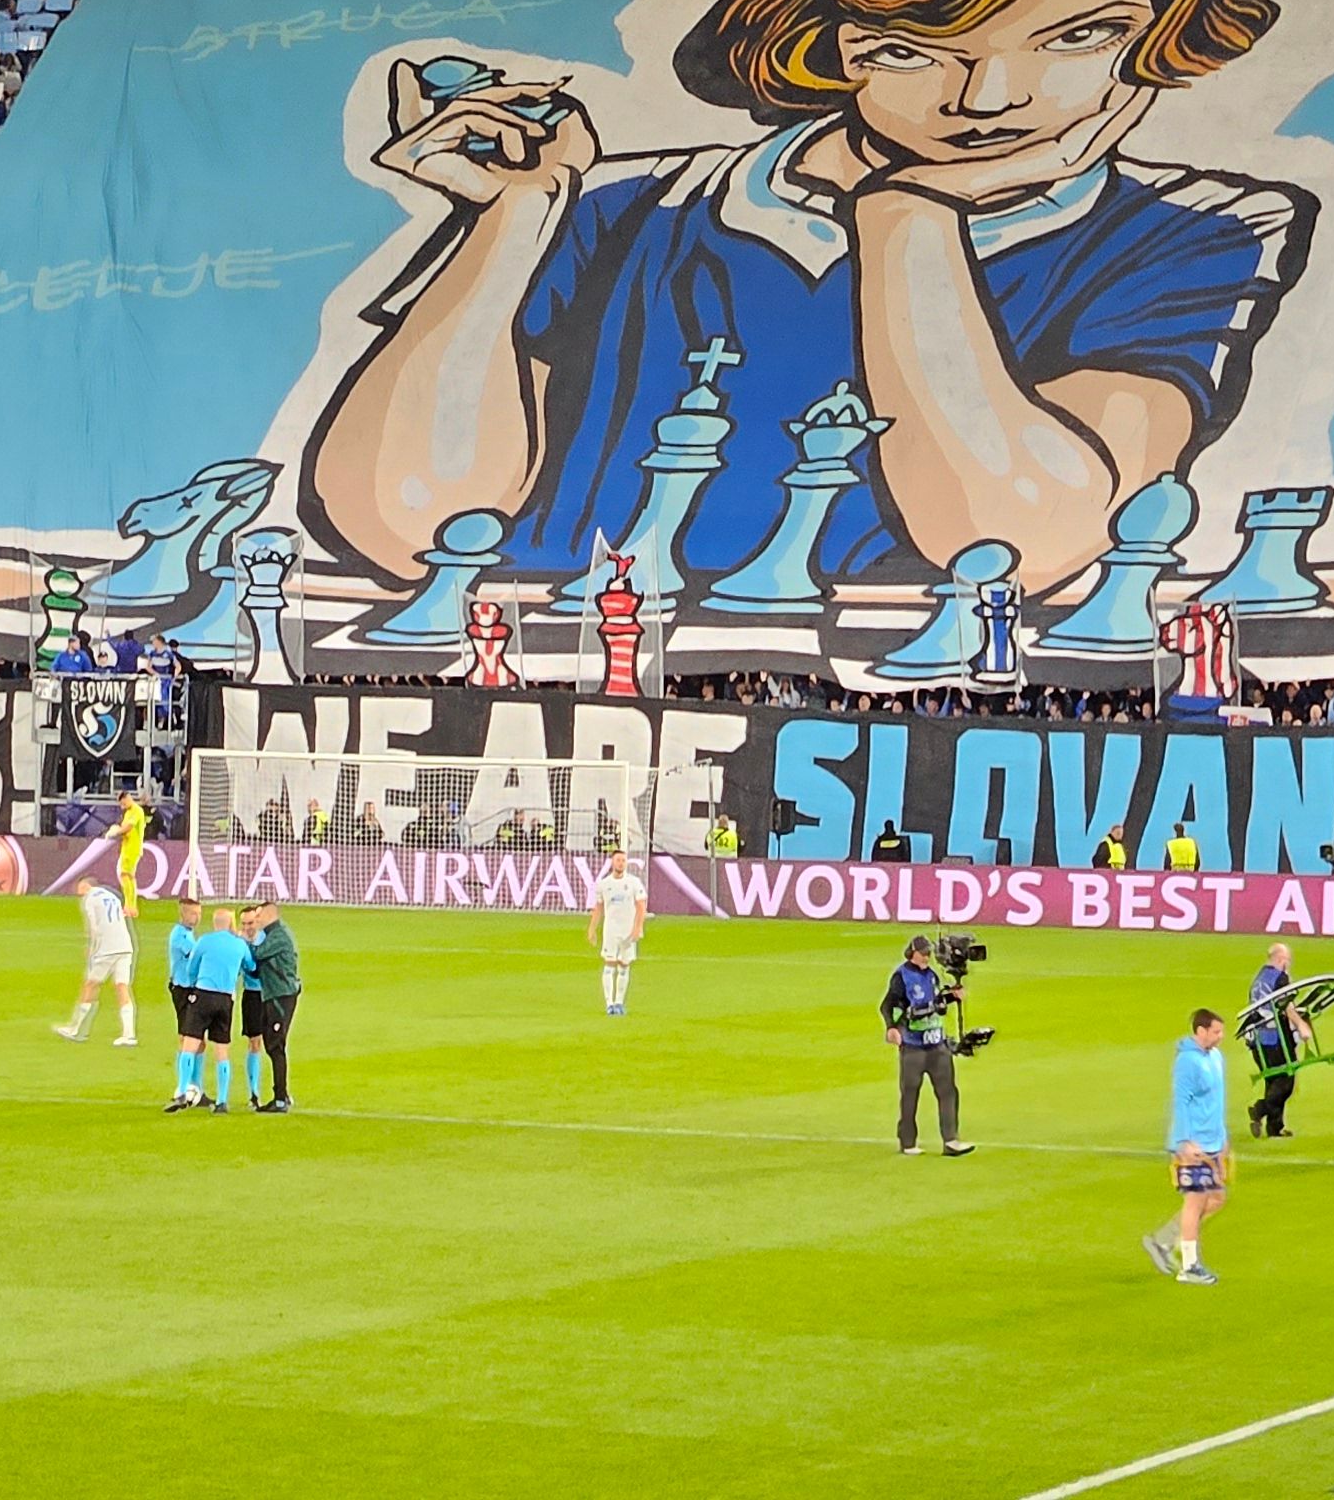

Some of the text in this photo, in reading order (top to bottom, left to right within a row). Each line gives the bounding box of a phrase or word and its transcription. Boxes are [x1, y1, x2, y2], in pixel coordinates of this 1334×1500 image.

[70, 681, 127, 705] SLOVAN
[222, 687, 434, 846] WE
[467, 701, 748, 858] ARE
[133, 844, 335, 902] QATAR
[725, 861, 1043, 927] WORLD'S
[1067, 873, 1244, 934] BEST
